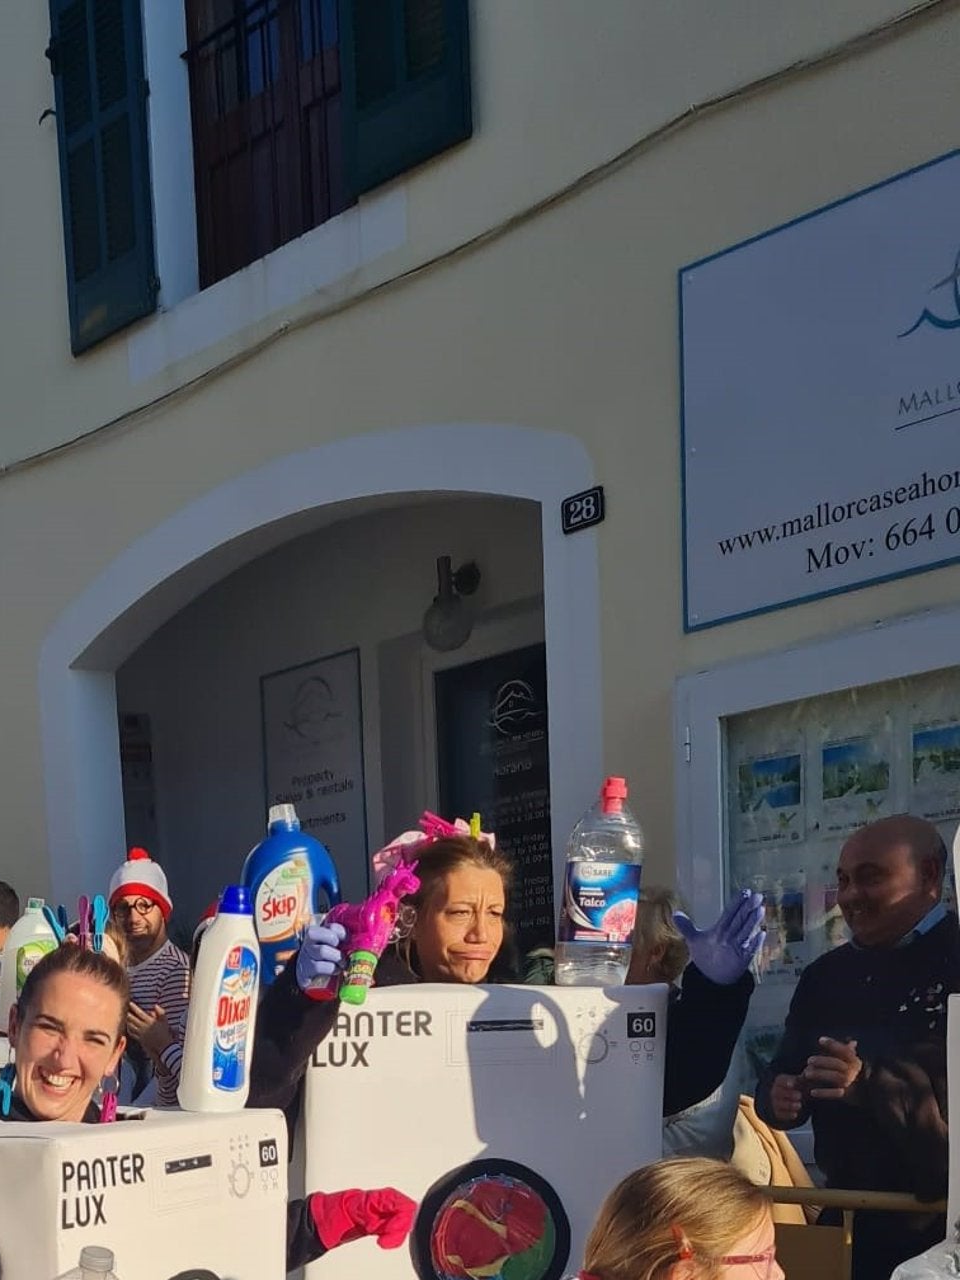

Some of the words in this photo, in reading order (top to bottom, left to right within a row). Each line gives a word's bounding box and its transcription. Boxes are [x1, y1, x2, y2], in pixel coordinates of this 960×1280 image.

[898, 380, 960, 415] MALL
[570, 496, 595, 524] 28
[806, 537, 875, 574] Mov:
[885, 513, 936, 552] 664
[262, 894, 297, 922] Skip
[579, 896, 606, 908] Talco
[333, 1010, 433, 1037] ANTER
[631, 1017, 655, 1034] 60
[311, 1041, 370, 1068] LUX
[62, 1153, 146, 1193] PANTER
[61, 1195, 107, 1230] LUX
